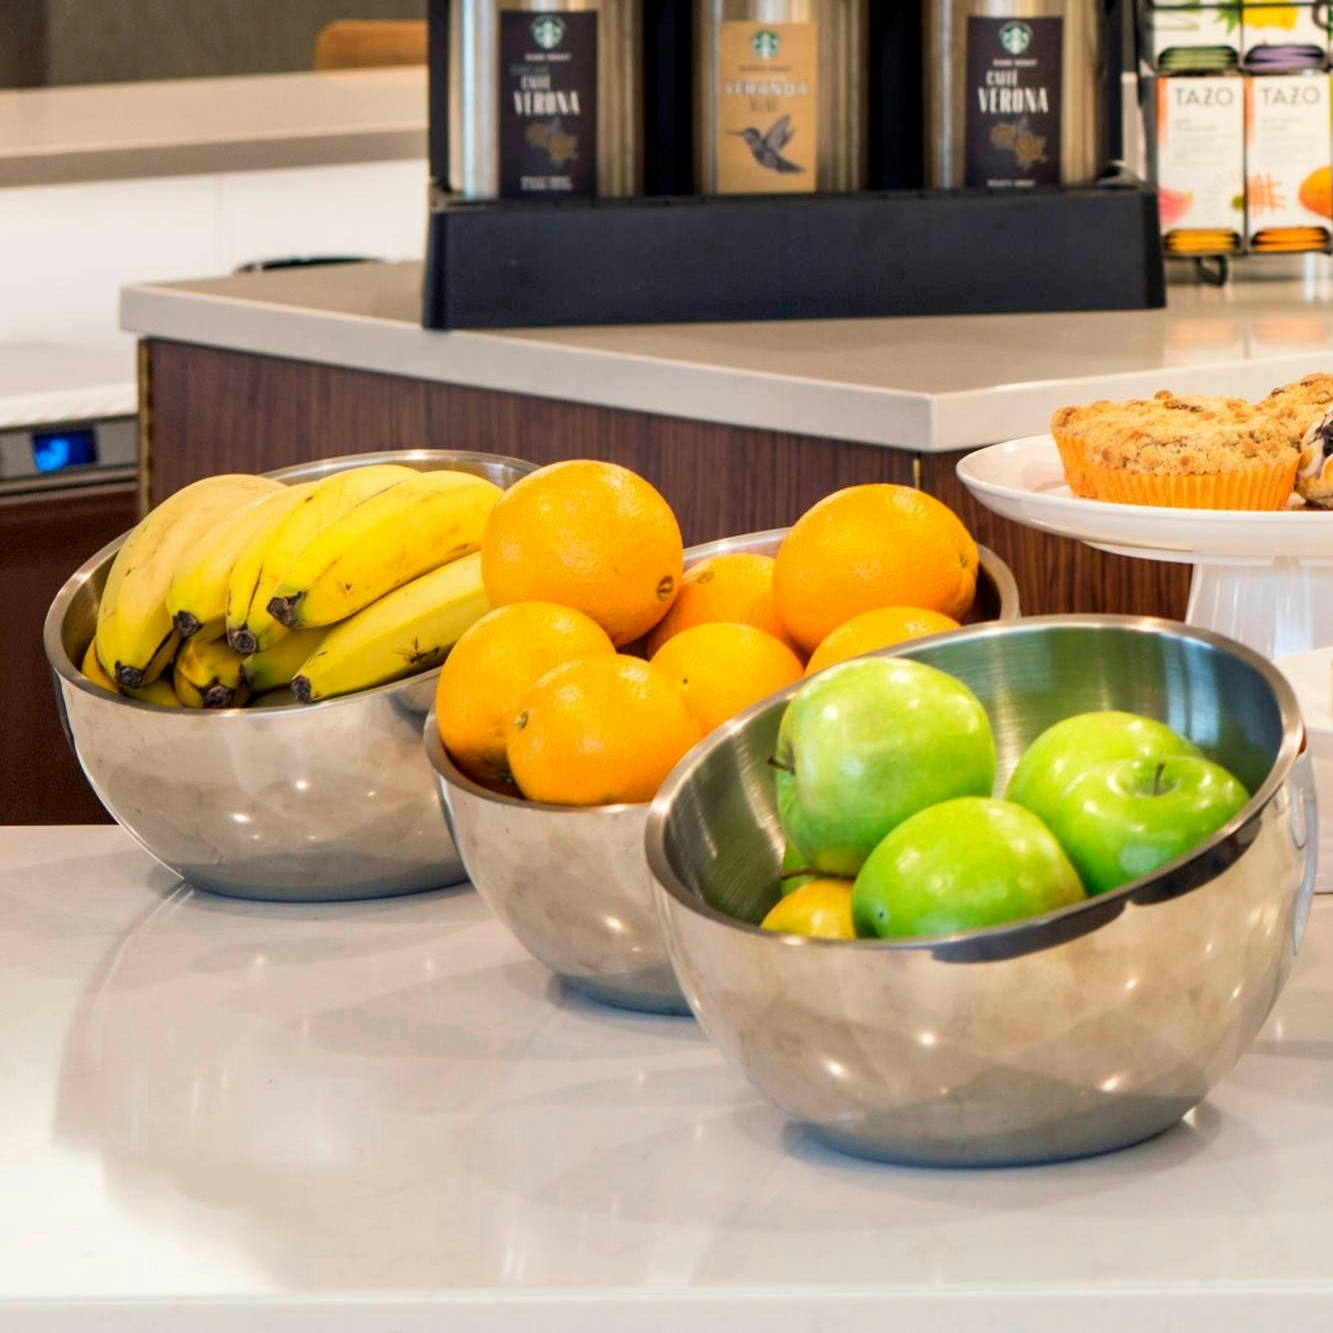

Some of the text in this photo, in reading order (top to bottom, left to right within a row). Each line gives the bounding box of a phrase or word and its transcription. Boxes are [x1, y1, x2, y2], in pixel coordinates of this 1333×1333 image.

[725, 80, 808, 98] VERANDA
[1173, 86, 1235, 107] TAZO
[1259, 85, 1322, 106] TAZO
[513, 90, 580, 115] VERONA
[978, 87, 1049, 115] VERONA
